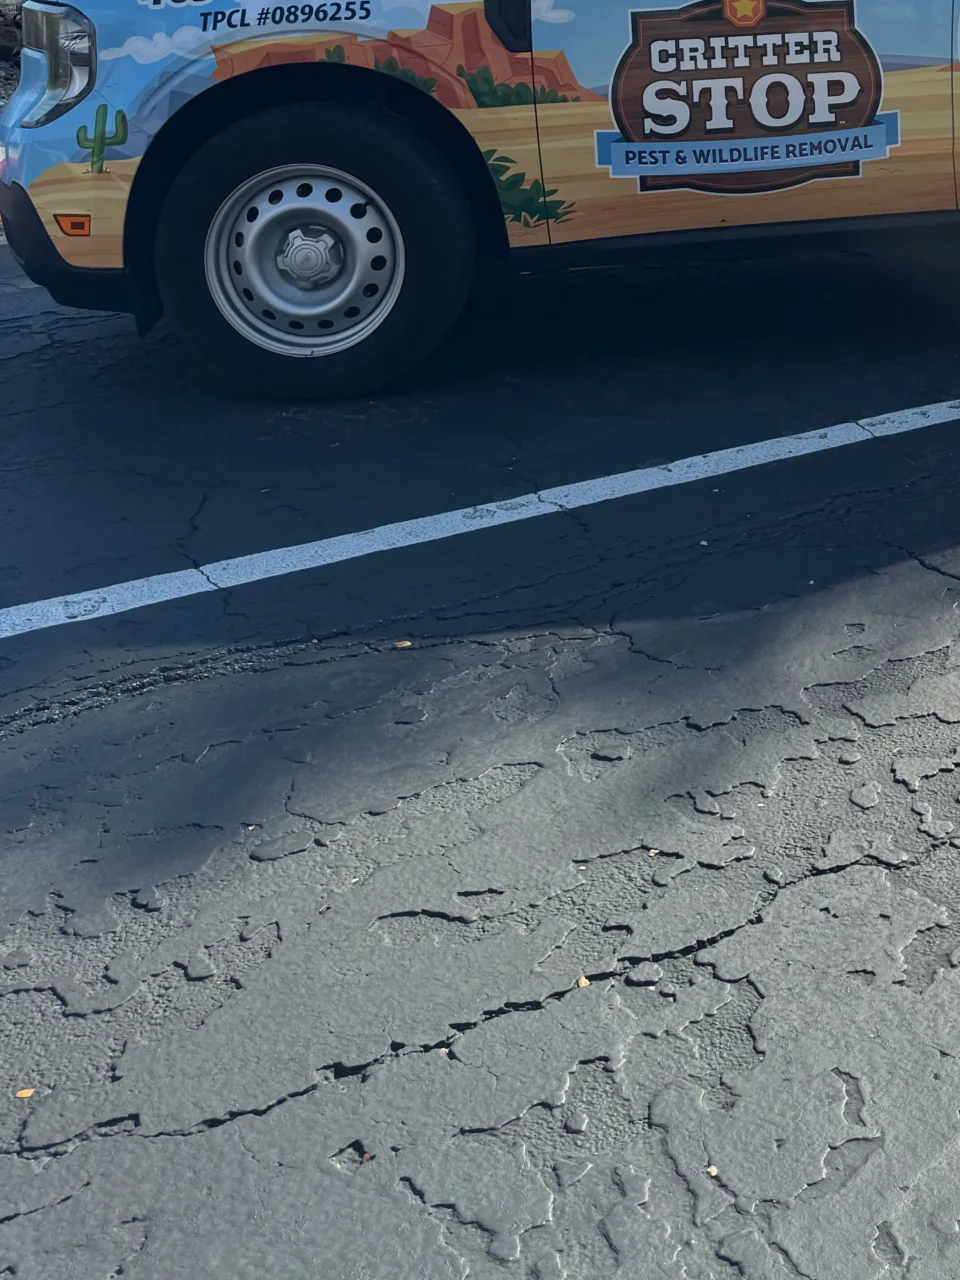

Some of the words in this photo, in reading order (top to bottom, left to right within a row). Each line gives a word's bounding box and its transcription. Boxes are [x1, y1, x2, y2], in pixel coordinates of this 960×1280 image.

[200, 8, 251, 33] TPCL
[256, 0, 372, 26] #0896255
[650, 31, 841, 73] CRITTER
[642, 71, 863, 135] STOP
[624, 149, 671, 166] PEST
[674, 149, 688, 166] &
[692, 145, 781, 165] WILDLIFE
[785, 134, 874, 159] REMOVAL
